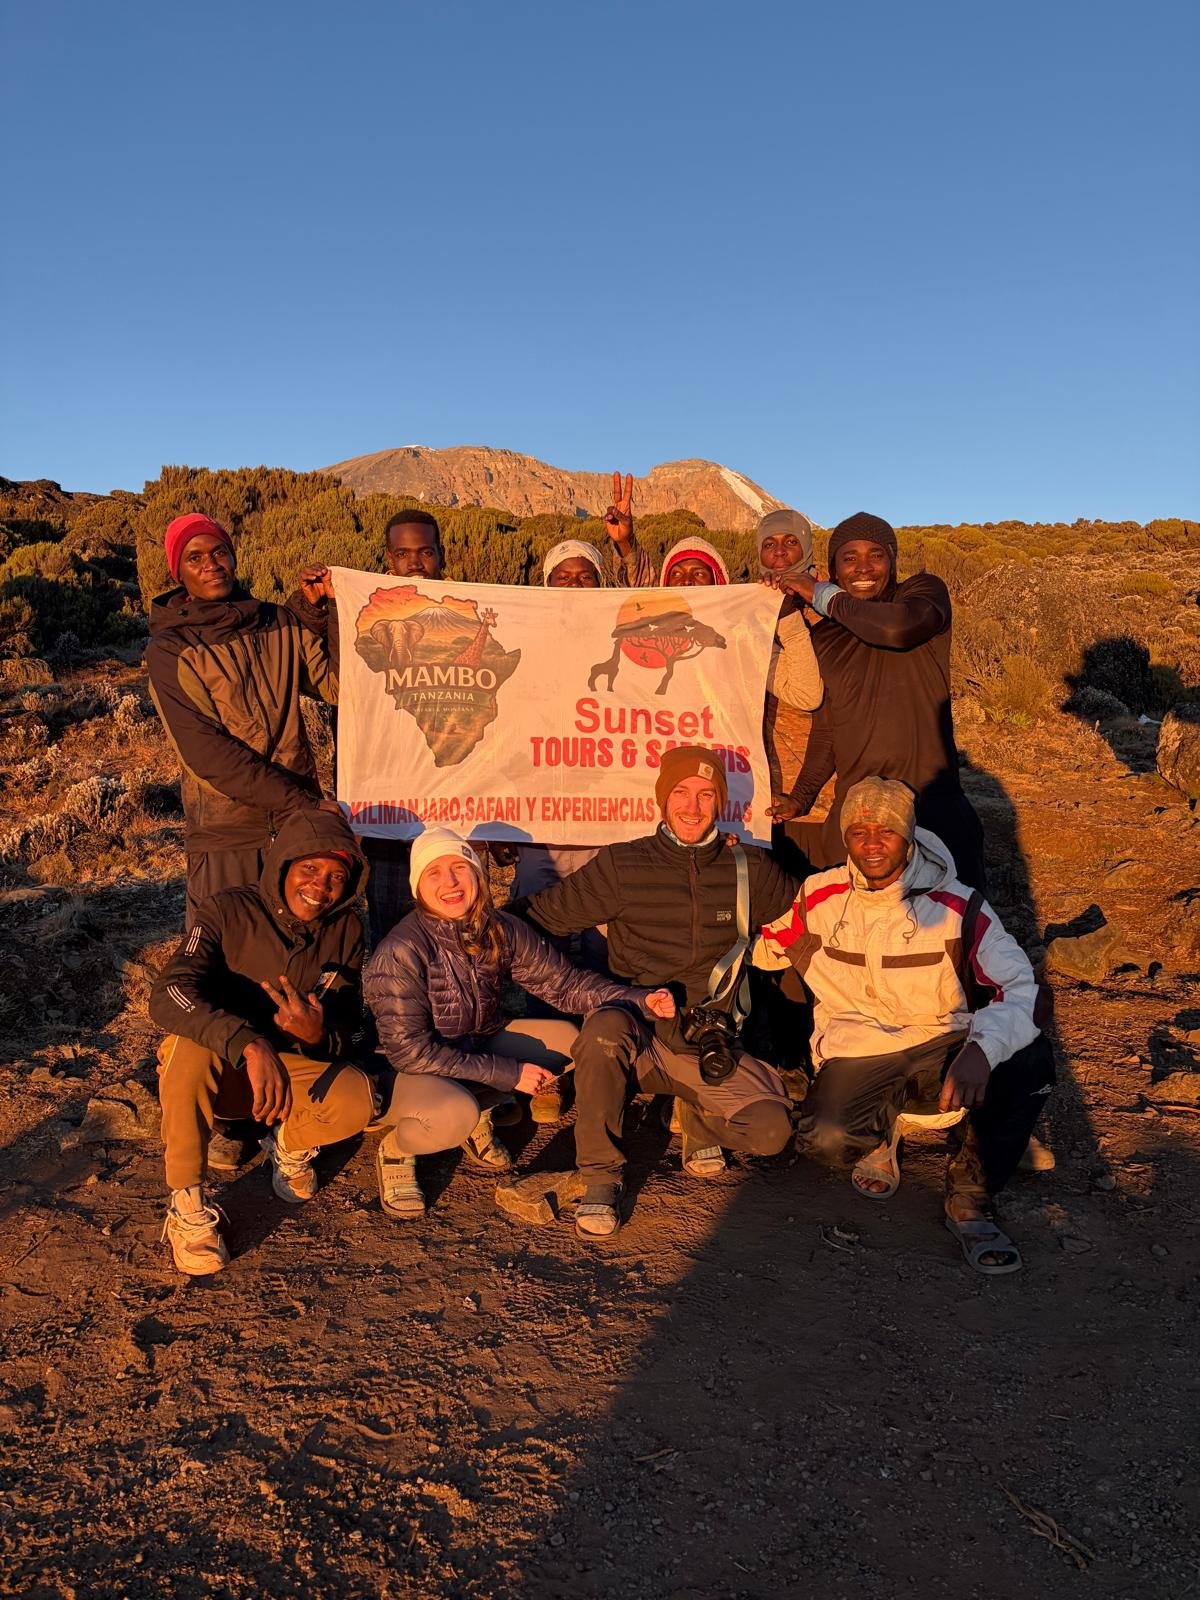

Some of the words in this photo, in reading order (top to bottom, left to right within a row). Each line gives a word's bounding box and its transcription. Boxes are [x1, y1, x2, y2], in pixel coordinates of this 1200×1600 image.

[388, 666, 497, 690] MAMBO
[413, 691, 474, 701] TANZANIA
[574, 697, 714, 739] Sunset
[530, 736, 613, 768] TOURS
[621, 738, 639, 769] &
[526, 796, 537, 822] Y
[541, 796, 656, 823] EXPERIENCIAS
